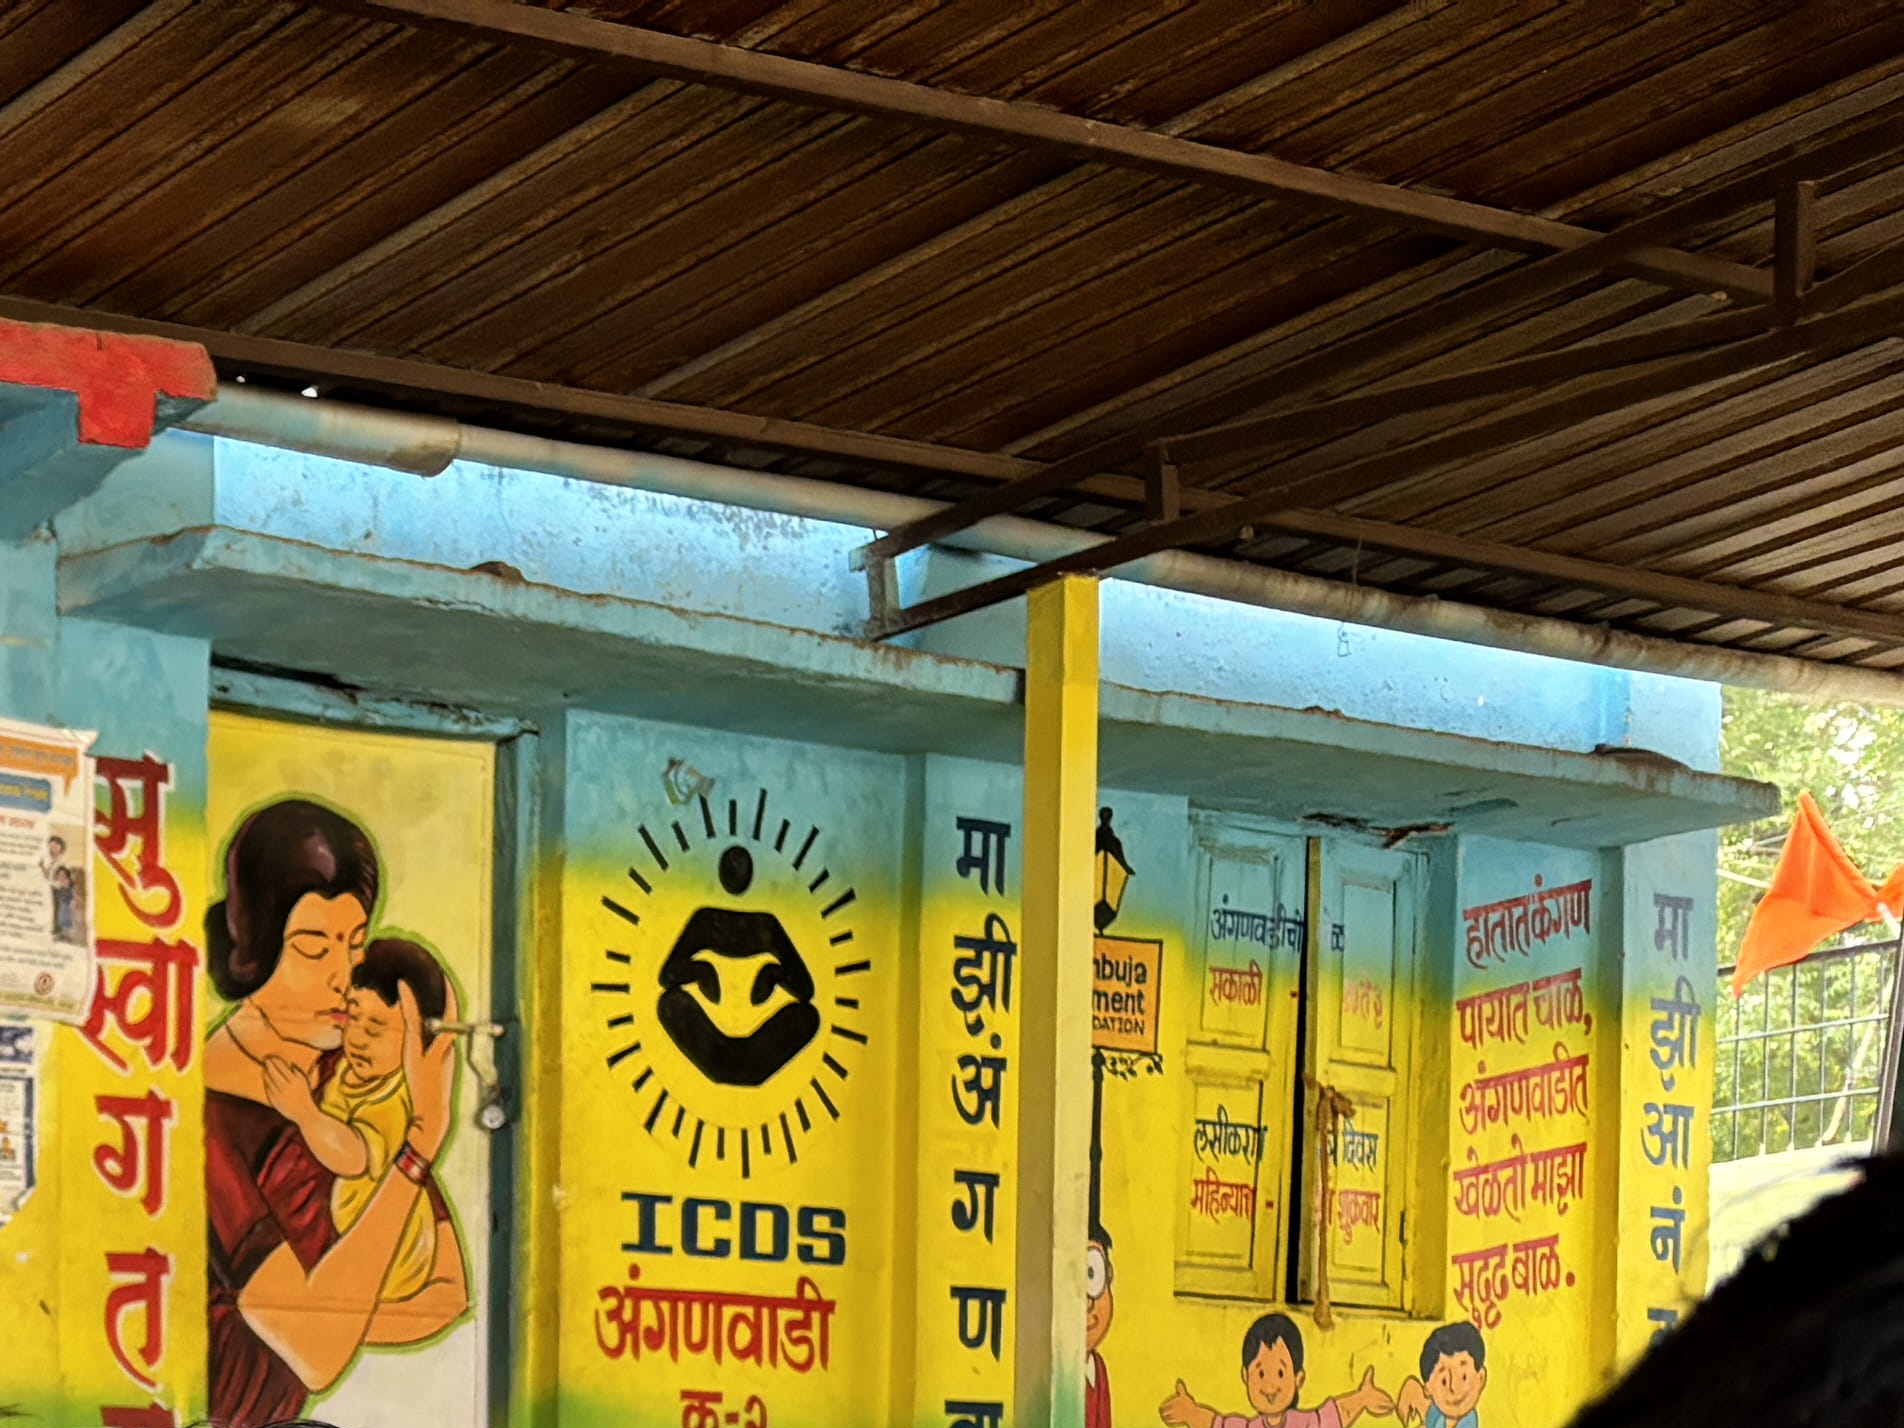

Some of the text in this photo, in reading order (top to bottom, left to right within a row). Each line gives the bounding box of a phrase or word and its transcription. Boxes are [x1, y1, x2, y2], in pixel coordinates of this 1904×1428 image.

[1093, 952, 1148, 988] buja
[1093, 988, 1145, 1016] ment
[1092, 1015, 1145, 1036] DATION
[1456, 981, 1530, 1051] पायात
[1459, 1041, 1590, 1135] अंगणवाडीत
[1453, 1133, 1588, 1222] खेळतो माझा
[621, 1190, 846, 1266] ICDS
[594, 1264, 836, 1374] अंगणवाडी
